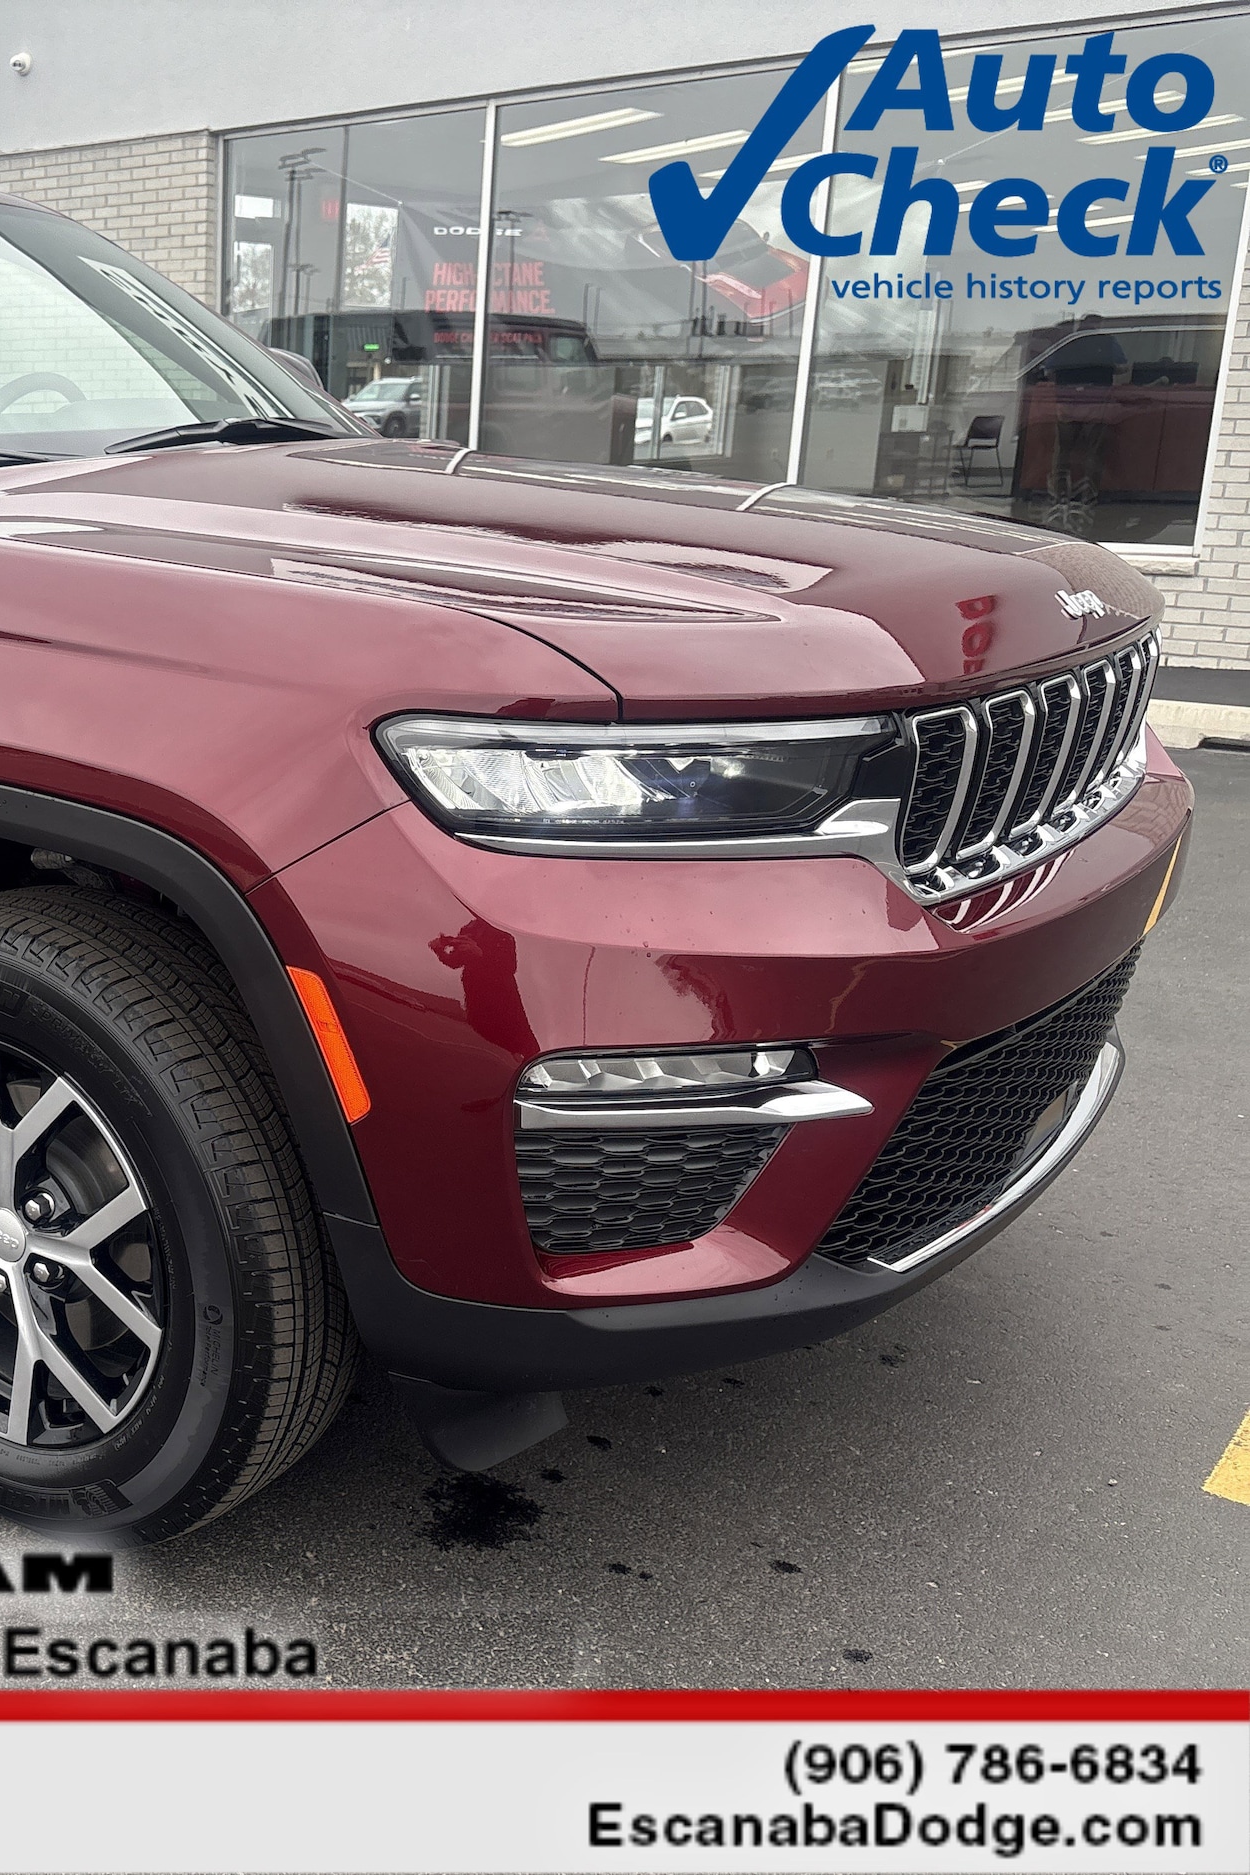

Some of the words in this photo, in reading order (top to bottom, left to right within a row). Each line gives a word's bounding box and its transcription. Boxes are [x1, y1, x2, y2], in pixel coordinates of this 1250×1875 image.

[424, 289, 555, 314] PERFMANCE.
[1054, 589, 1105, 620] Jeep
[210, 1328, 222, 1376] MICHELIN
